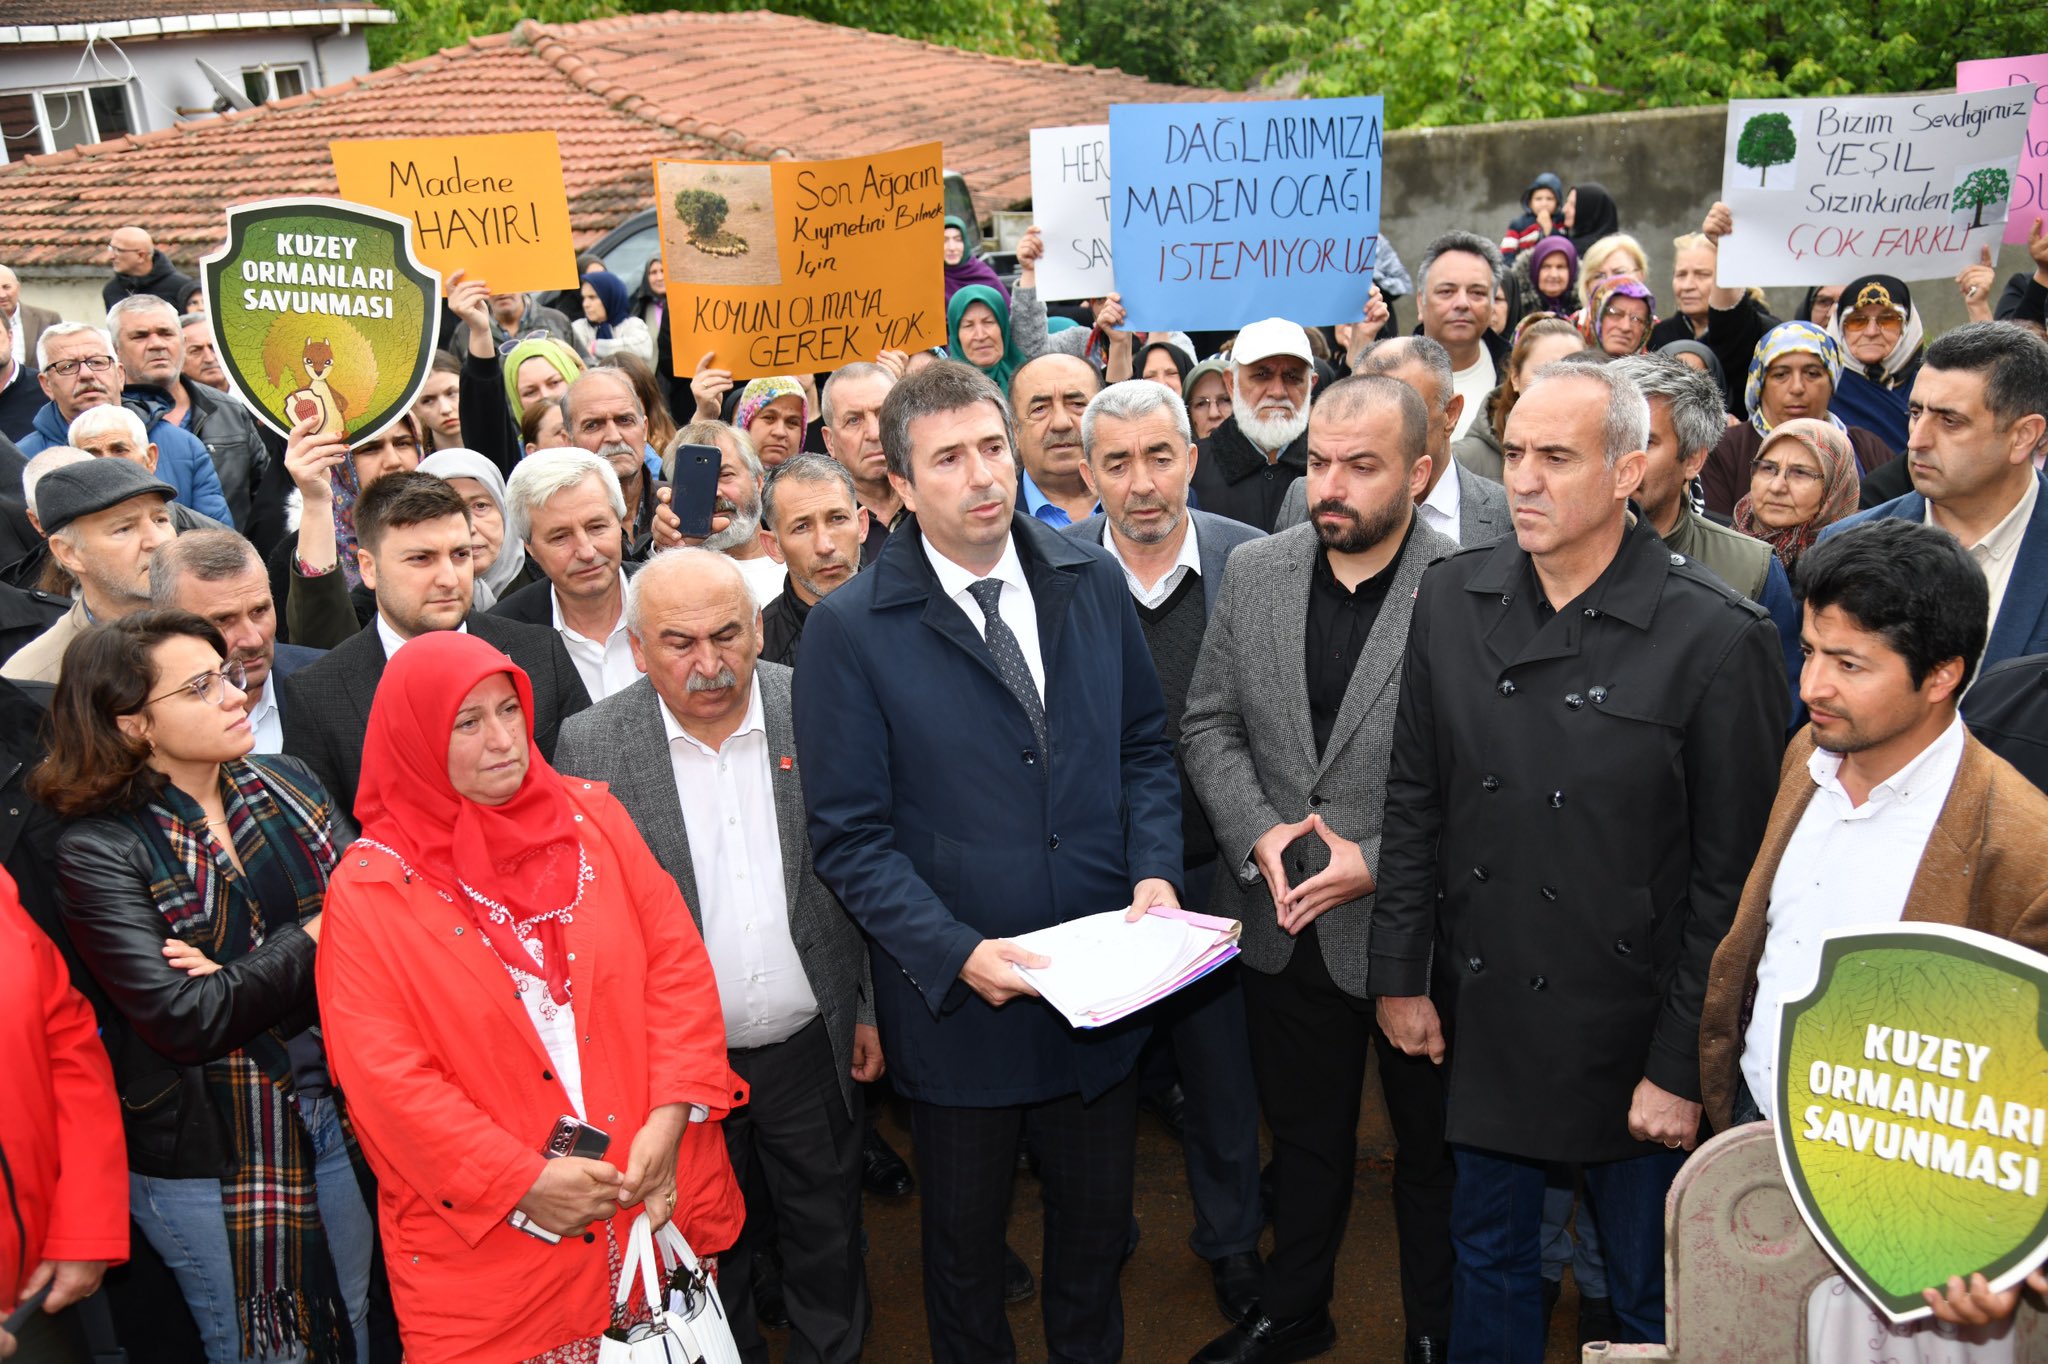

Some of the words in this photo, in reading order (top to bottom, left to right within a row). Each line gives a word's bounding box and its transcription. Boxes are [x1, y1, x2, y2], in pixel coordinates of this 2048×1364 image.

[1165, 115, 1383, 164] DAĞLARIMIZA
[1816, 106, 1893, 137] Bizim
[389, 156, 514, 198] Madene
[1062, 141, 1111, 183] HER
[796, 170, 853, 211] Son
[860, 164, 940, 212] Ağacın
[1123, 177, 1258, 228] MADEN
[1270, 168, 1371, 219] OCAĞI
[1805, 180, 1950, 215] Sizinkinden
[277, 233, 358, 260] KUZEY
[414, 202, 541, 250] HAYIR!
[793, 216, 886, 251] Kıymetini
[1787, 223, 1864, 261] ÇOK
[242, 260, 394, 291] ORMANLARI
[796, 243, 838, 278] İçin
[243, 288, 394, 319] SAVUNMASI
[693, 296, 780, 335] KOYUN
[789, 288, 888, 328] OLMAYA
[750, 325, 862, 367] GEREK
[875, 310, 932, 349] YOK.
[1863, 1023, 1991, 1083] KUZEY
[1808, 1060, 2046, 1147] ORMANLARI
[1803, 1105, 2041, 1197] SAVUNMASI
